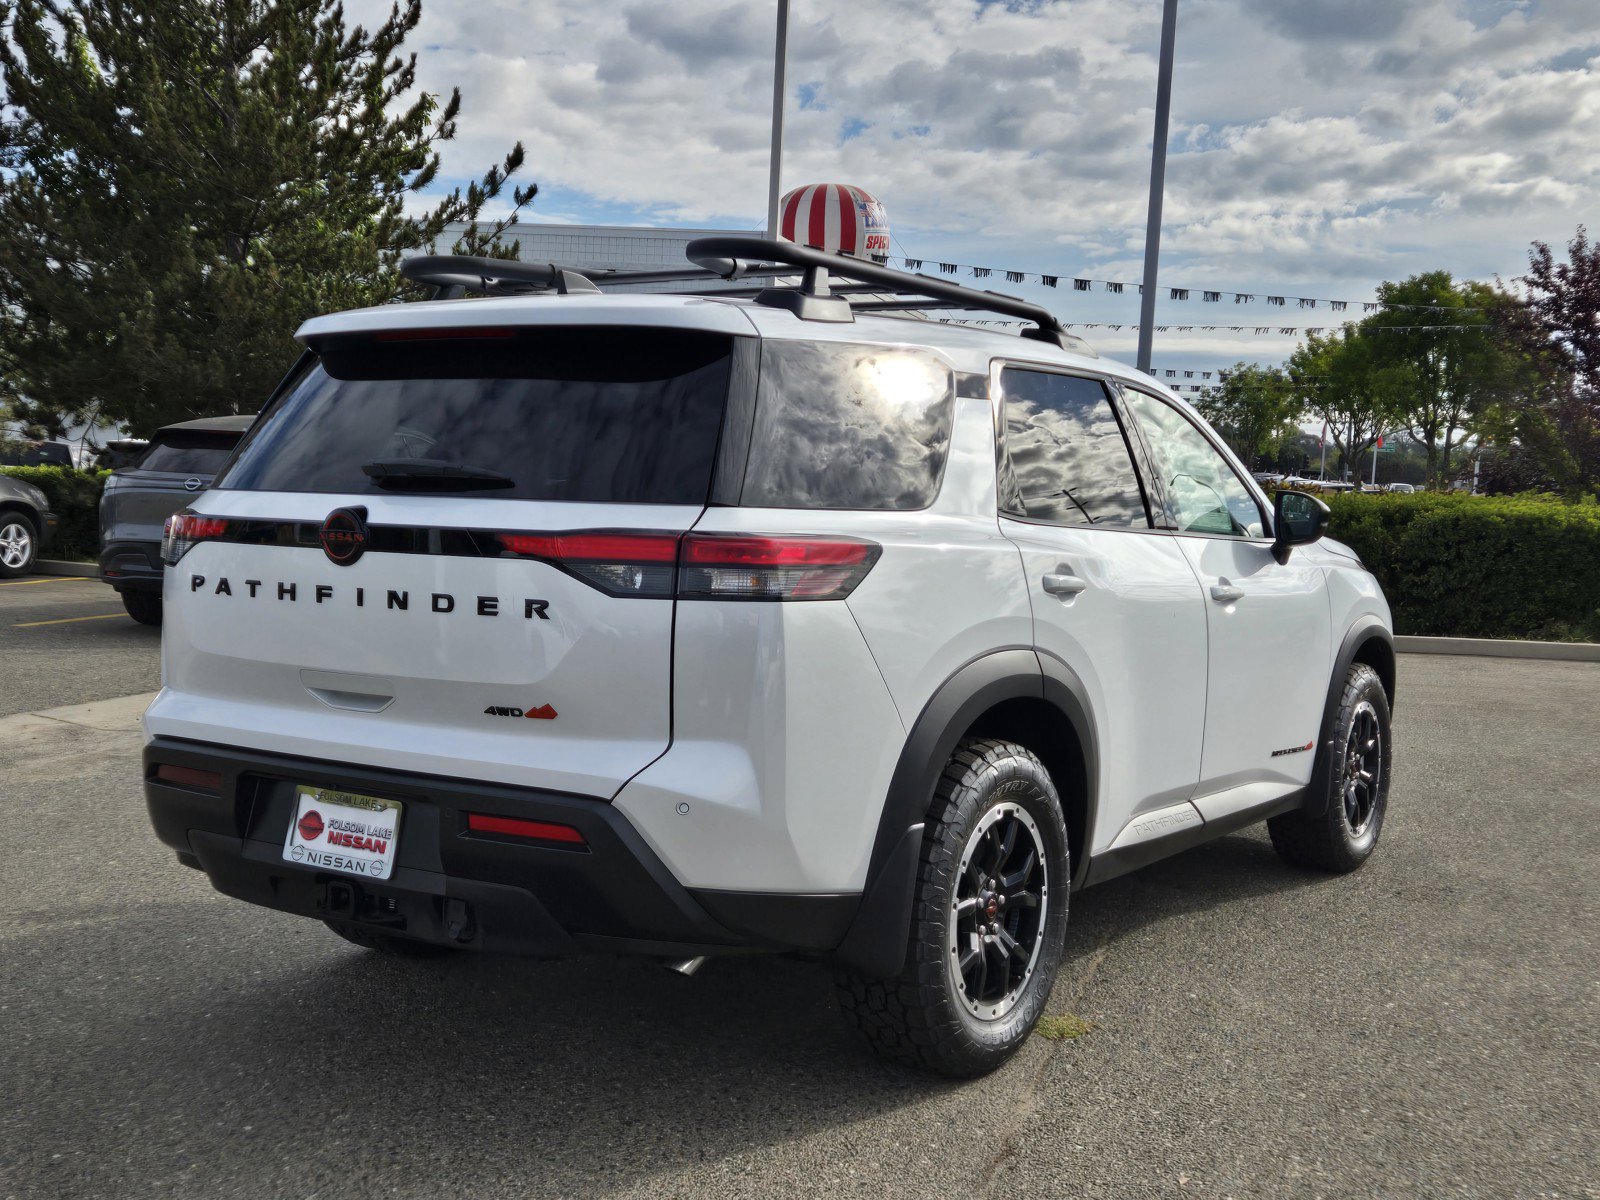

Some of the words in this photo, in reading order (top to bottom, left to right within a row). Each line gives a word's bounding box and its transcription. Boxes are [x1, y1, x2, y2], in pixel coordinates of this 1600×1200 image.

[319, 531, 364, 543] NISSAN
[191, 574, 551, 620] PATHFINDER
[483, 705, 524, 717] 4WD
[320, 790, 353, 804] FOLSOM
[353, 796, 377, 809] LAKE
[328, 818, 366, 834] FOLSOM
[367, 825, 392, 839] LAKE
[1133, 810, 1198, 836] PATHFINDER
[328, 831, 387, 854] NISSAN
[307, 852, 366, 872] NISSAN
